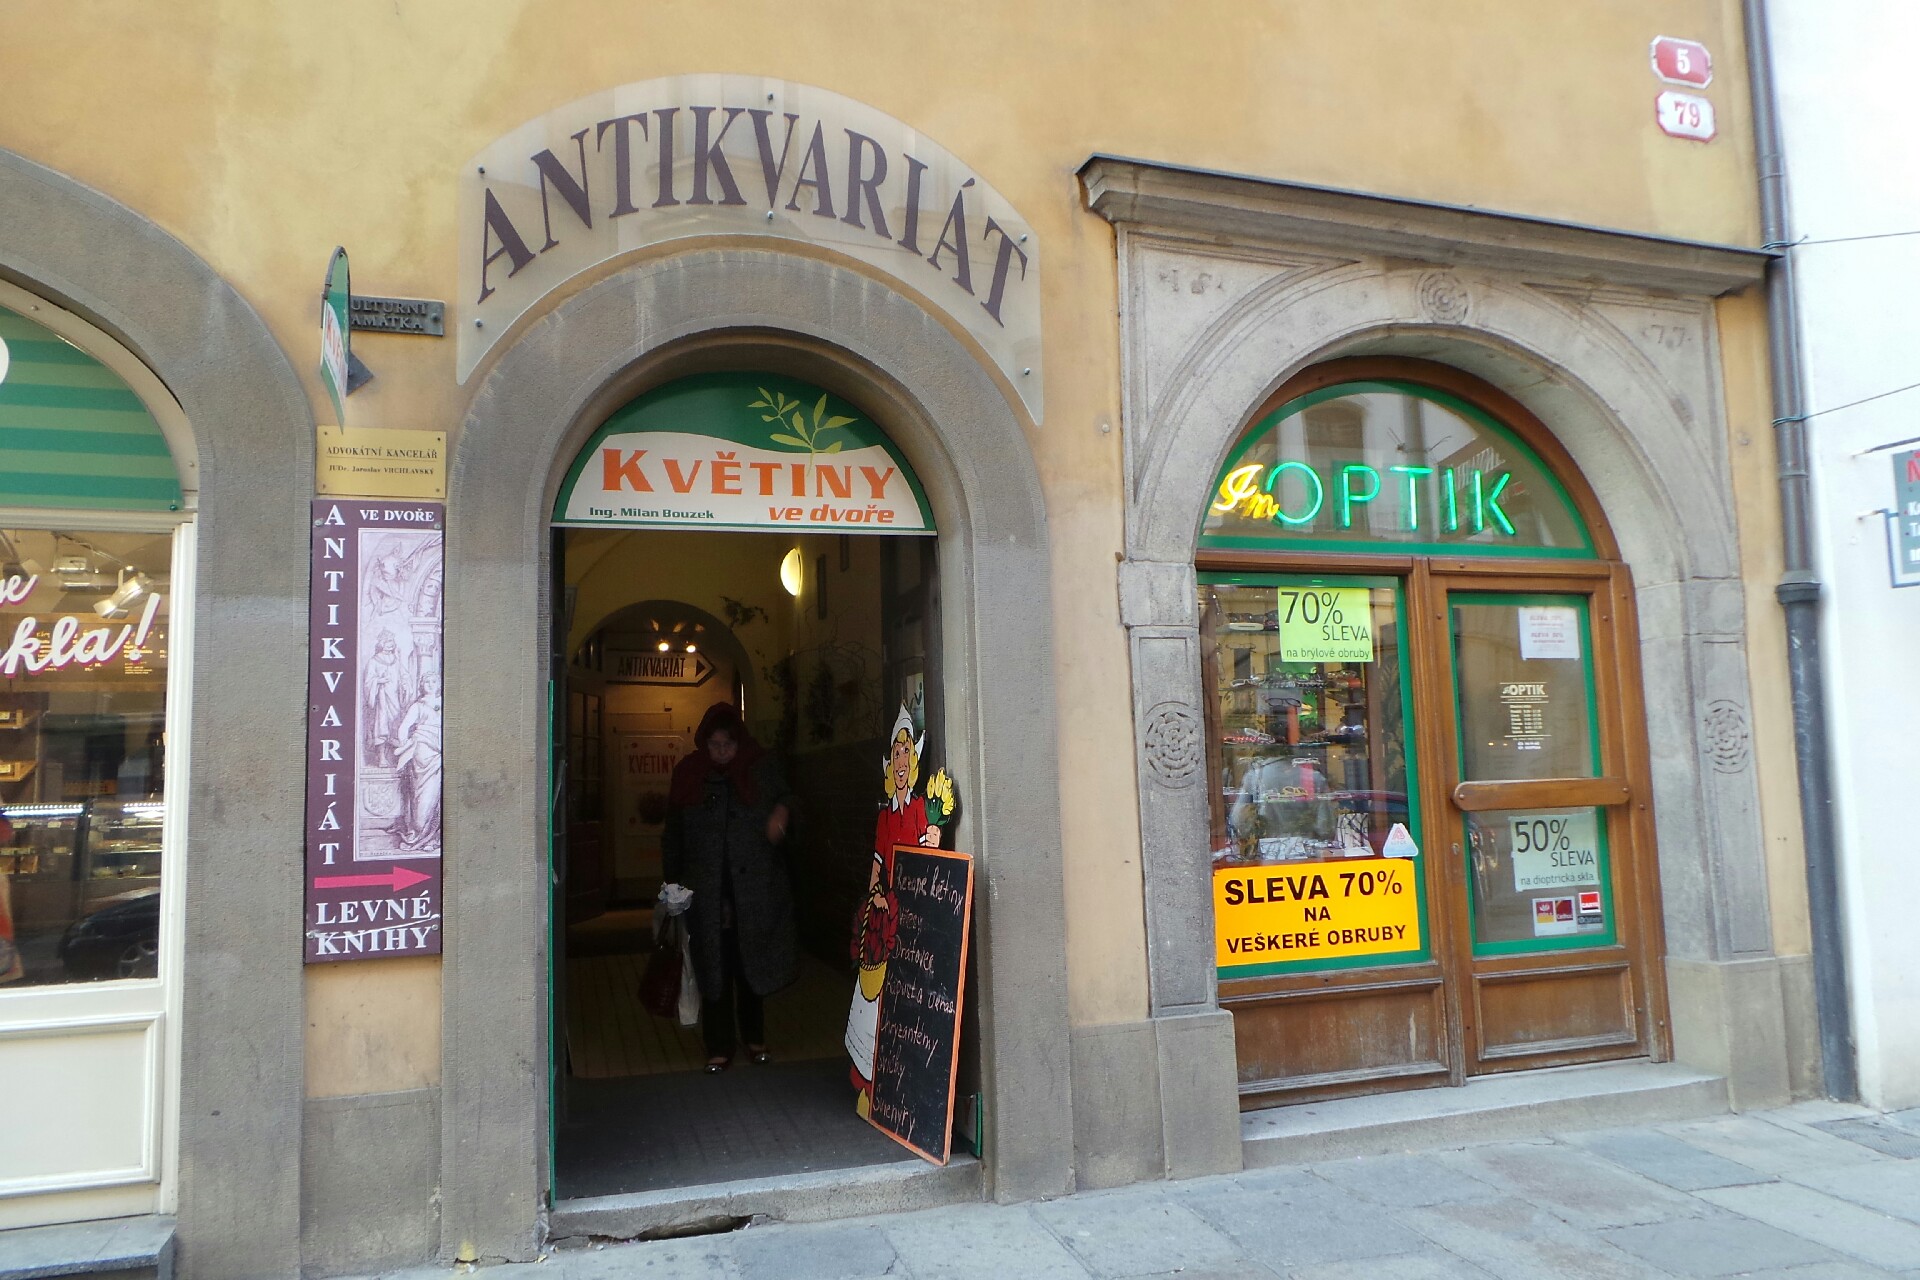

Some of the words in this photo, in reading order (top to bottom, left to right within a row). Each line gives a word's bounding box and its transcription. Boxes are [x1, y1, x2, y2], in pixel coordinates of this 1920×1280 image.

[1676, 48, 1691, 75] 5
[1674, 100, 1701, 128] 79
[477, 105, 1029, 328] ANTIKVARIÁT
[350, 299, 428, 316] ULTURNÍ
[350, 313, 424, 331] AMÁTKA
[326, 446, 382, 457] ADVOKÁTNÍ
[386, 448, 438, 459] KANCELÁŘ
[352, 465, 381, 473] Jaroslav
[602, 448, 895, 499] KVĚTINY
[1266, 461, 1516, 535] OPTIK
[360, 509, 379, 521] VE
[384, 508, 435, 522] DVOŘE
[589, 506, 617, 519] Ing.
[620, 507, 659, 518] Milan
[662, 508, 714, 519] Bouzek
[768, 506, 803, 521] ve
[809, 504, 895, 523] dvoře
[1281, 591, 1343, 624] 70%
[0, 592, 160, 678] kla!
[1322, 625, 1370, 641] SLEVA
[618, 654, 686, 678] ANTIKVARIÁT
[1286, 649, 1298, 658] na
[1301, 647, 1335, 660] brýlové
[1338, 647, 1370, 660] obruby
[317, 504, 346, 866] ANTIKVARIÁT
[1515, 819, 1570, 853] 50%
[1550, 850, 1595, 867] SLEVA
[1225, 875, 1330, 906] SLEVA
[1340, 870, 1403, 897] 70%
[1521, 876, 1531, 886] na
[315, 889, 432, 925] LEVNÉ
[1304, 906, 1331, 922] NA
[315, 926, 432, 956] KNIHY
[1226, 928, 1320, 954] VEŠKERÉ
[1327, 925, 1406, 946] OBRUBY
